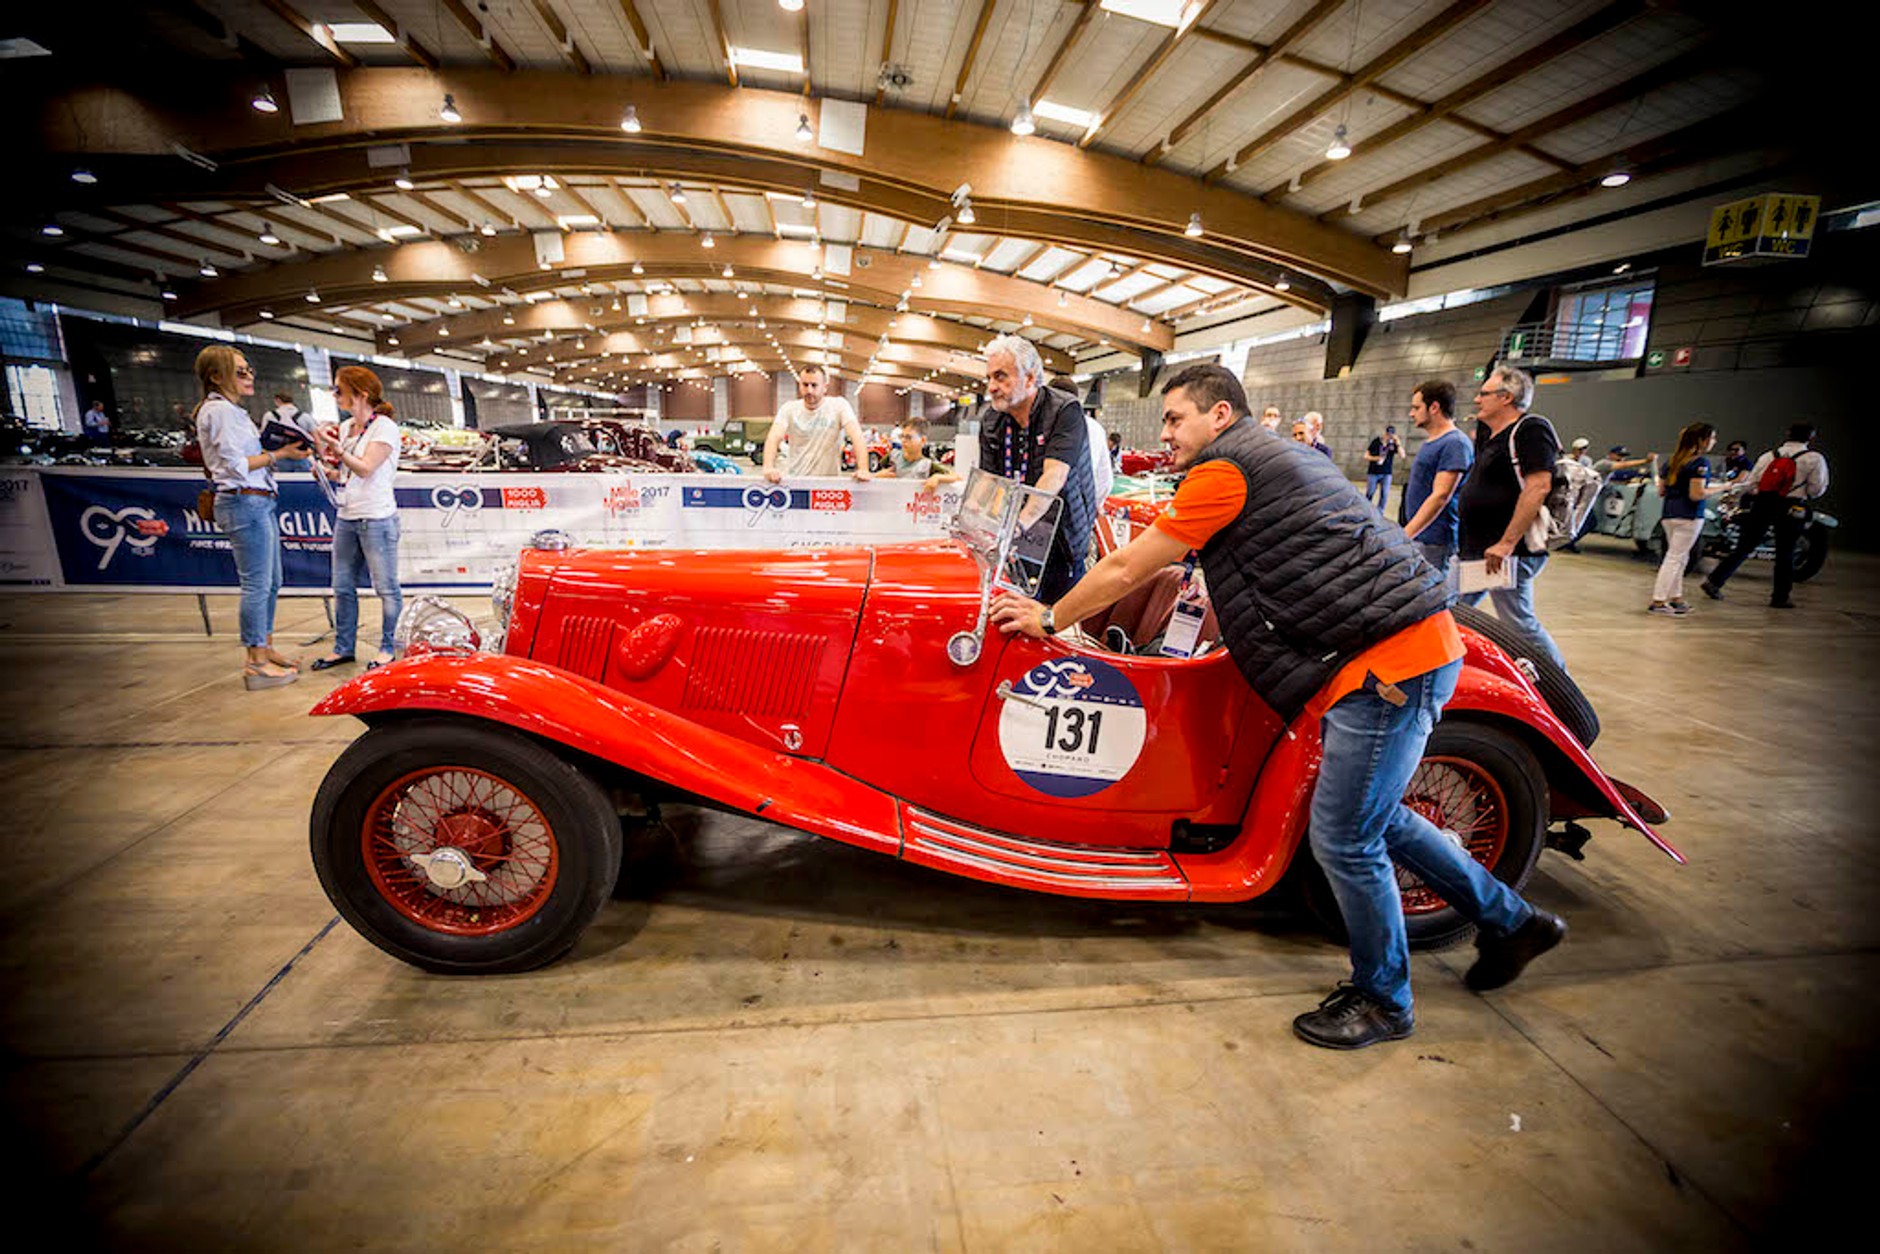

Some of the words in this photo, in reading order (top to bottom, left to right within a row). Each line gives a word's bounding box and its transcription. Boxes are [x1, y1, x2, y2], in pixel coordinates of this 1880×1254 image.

[1771, 239, 1796, 254] WC
[507, 489, 537, 499] 1000
[641, 486, 670, 498] 2017
[815, 491, 844, 500] 1000
[943, 493, 960, 504] 20
[182, 509, 224, 533] MIL
[279, 512, 333, 536] GLIA
[1045, 705, 1103, 754] 131
